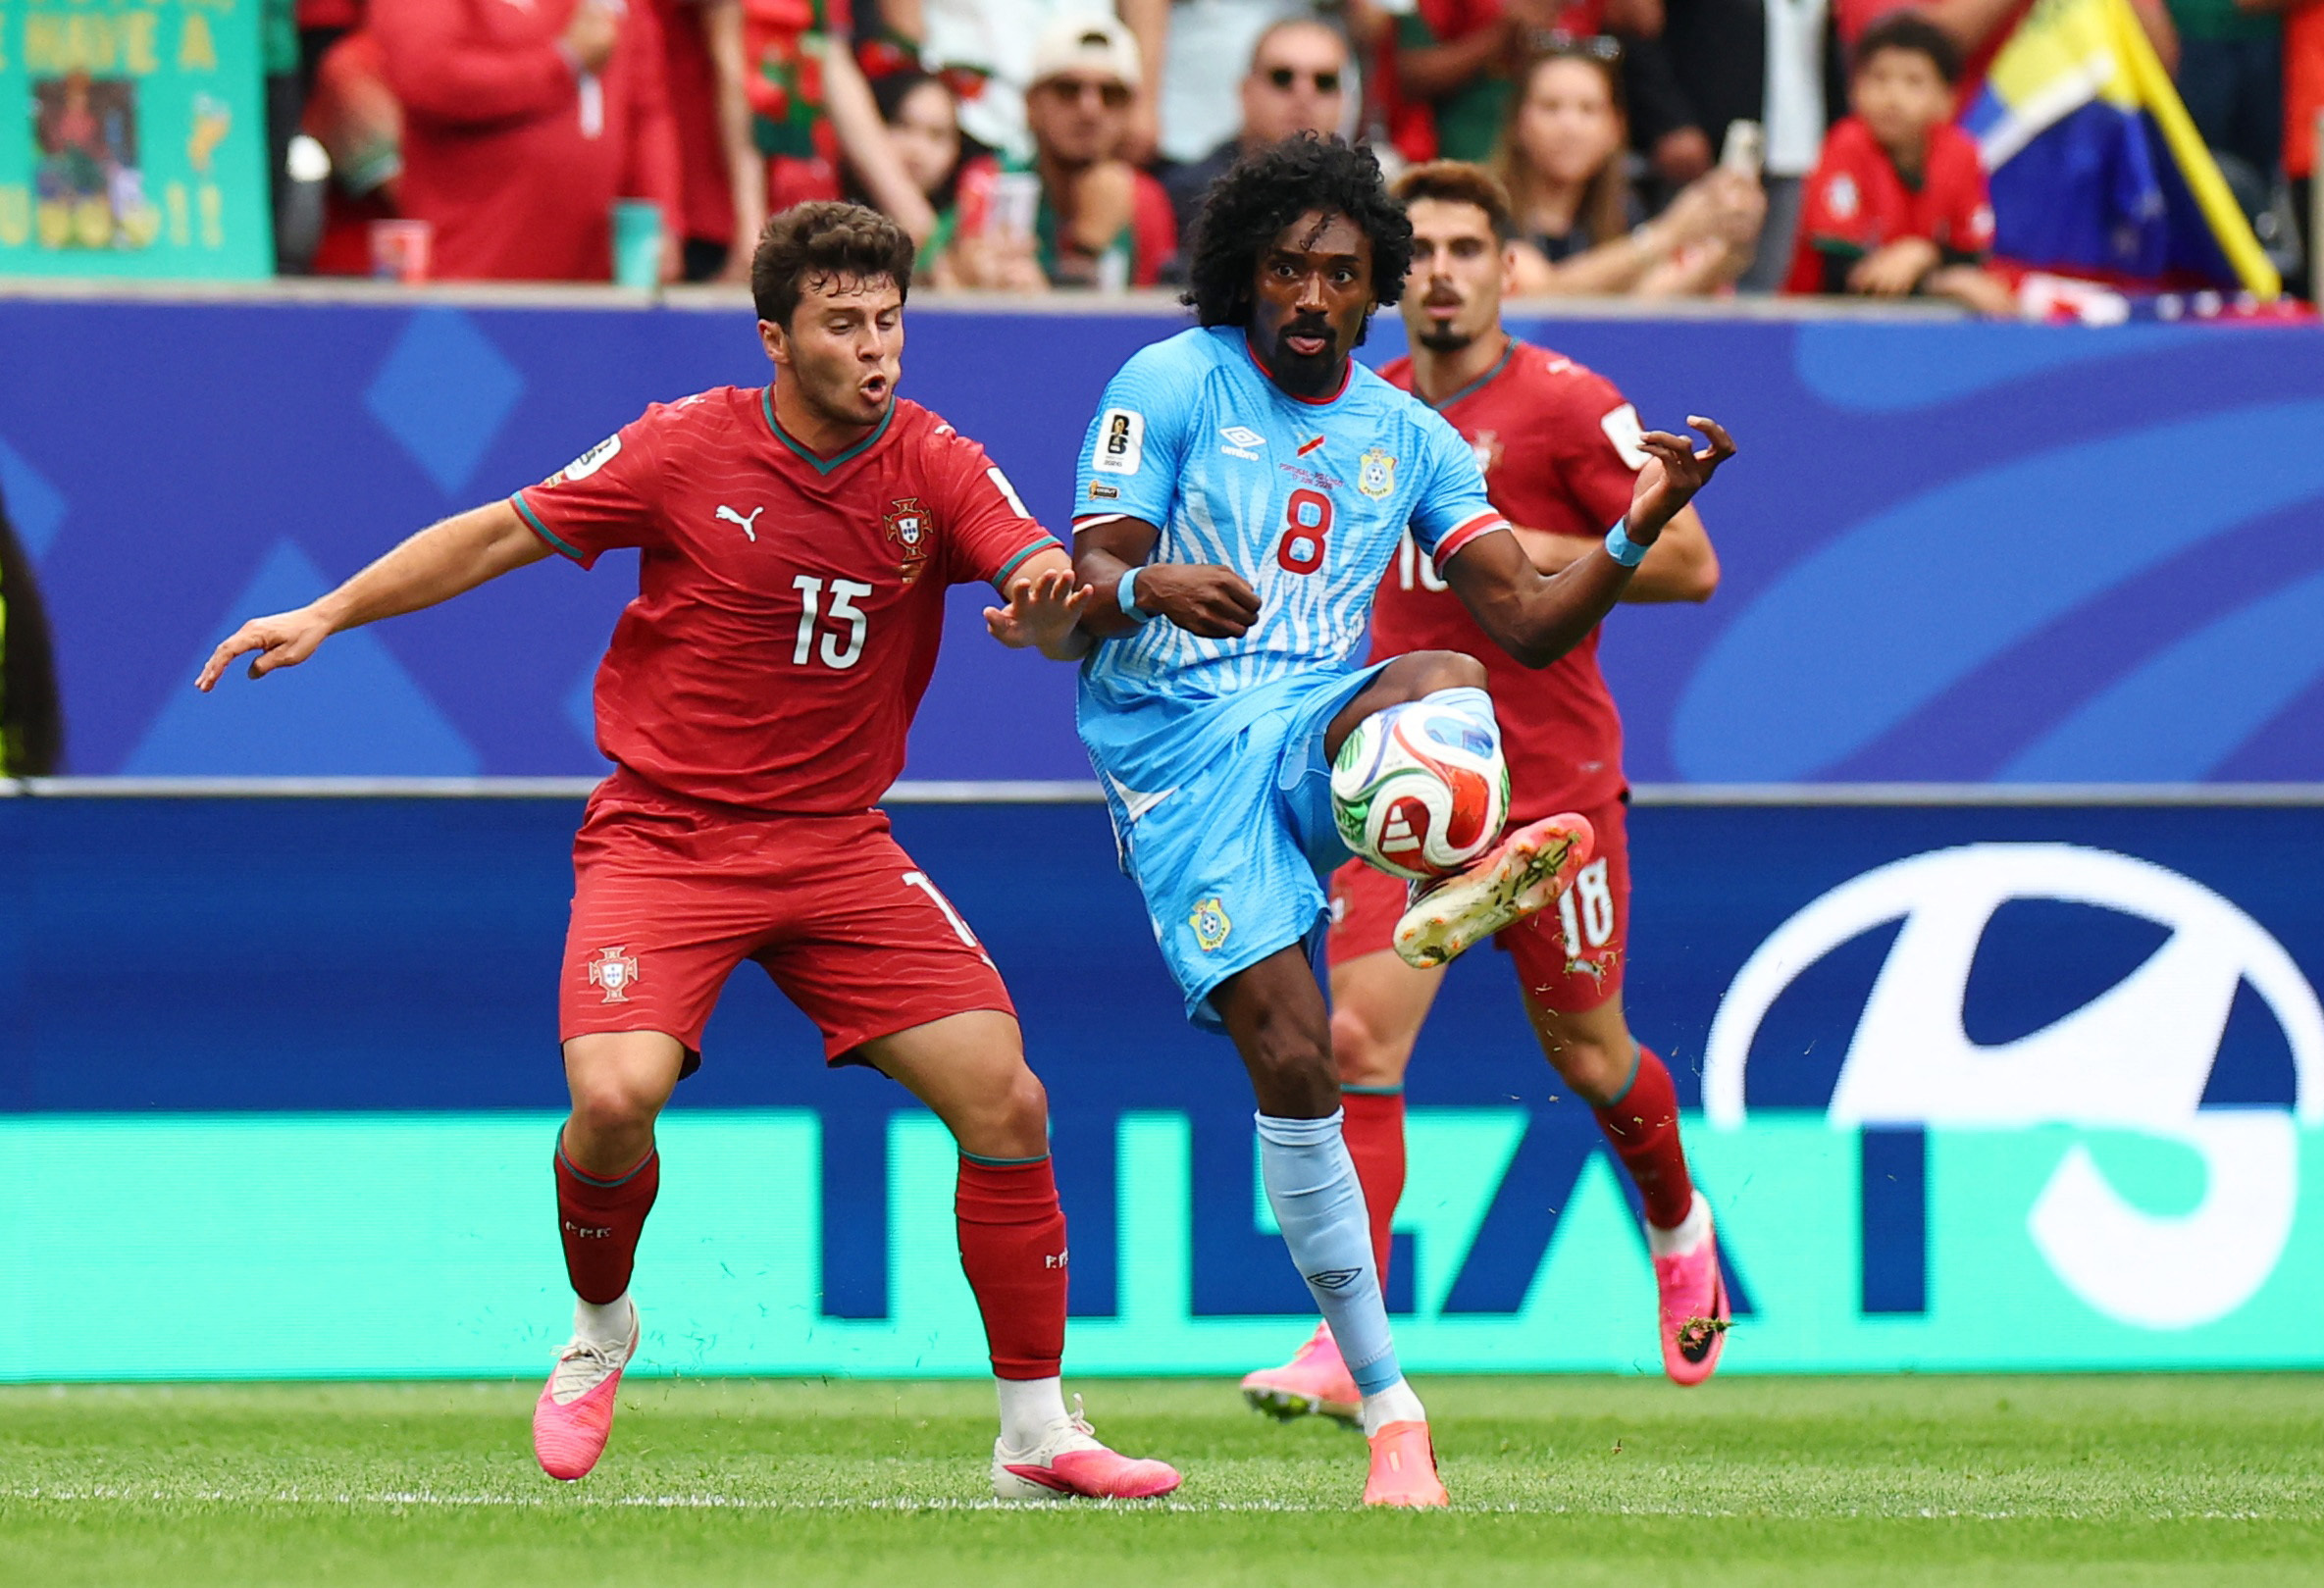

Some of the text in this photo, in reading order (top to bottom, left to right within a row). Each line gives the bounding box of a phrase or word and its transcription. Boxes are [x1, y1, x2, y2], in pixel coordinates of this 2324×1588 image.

[1220, 444, 1260, 462] umbro
[1277, 488, 1332, 575] 8
[793, 574, 872, 669] 15
[902, 871, 999, 971] 1
[1558, 856, 1615, 958] 18
